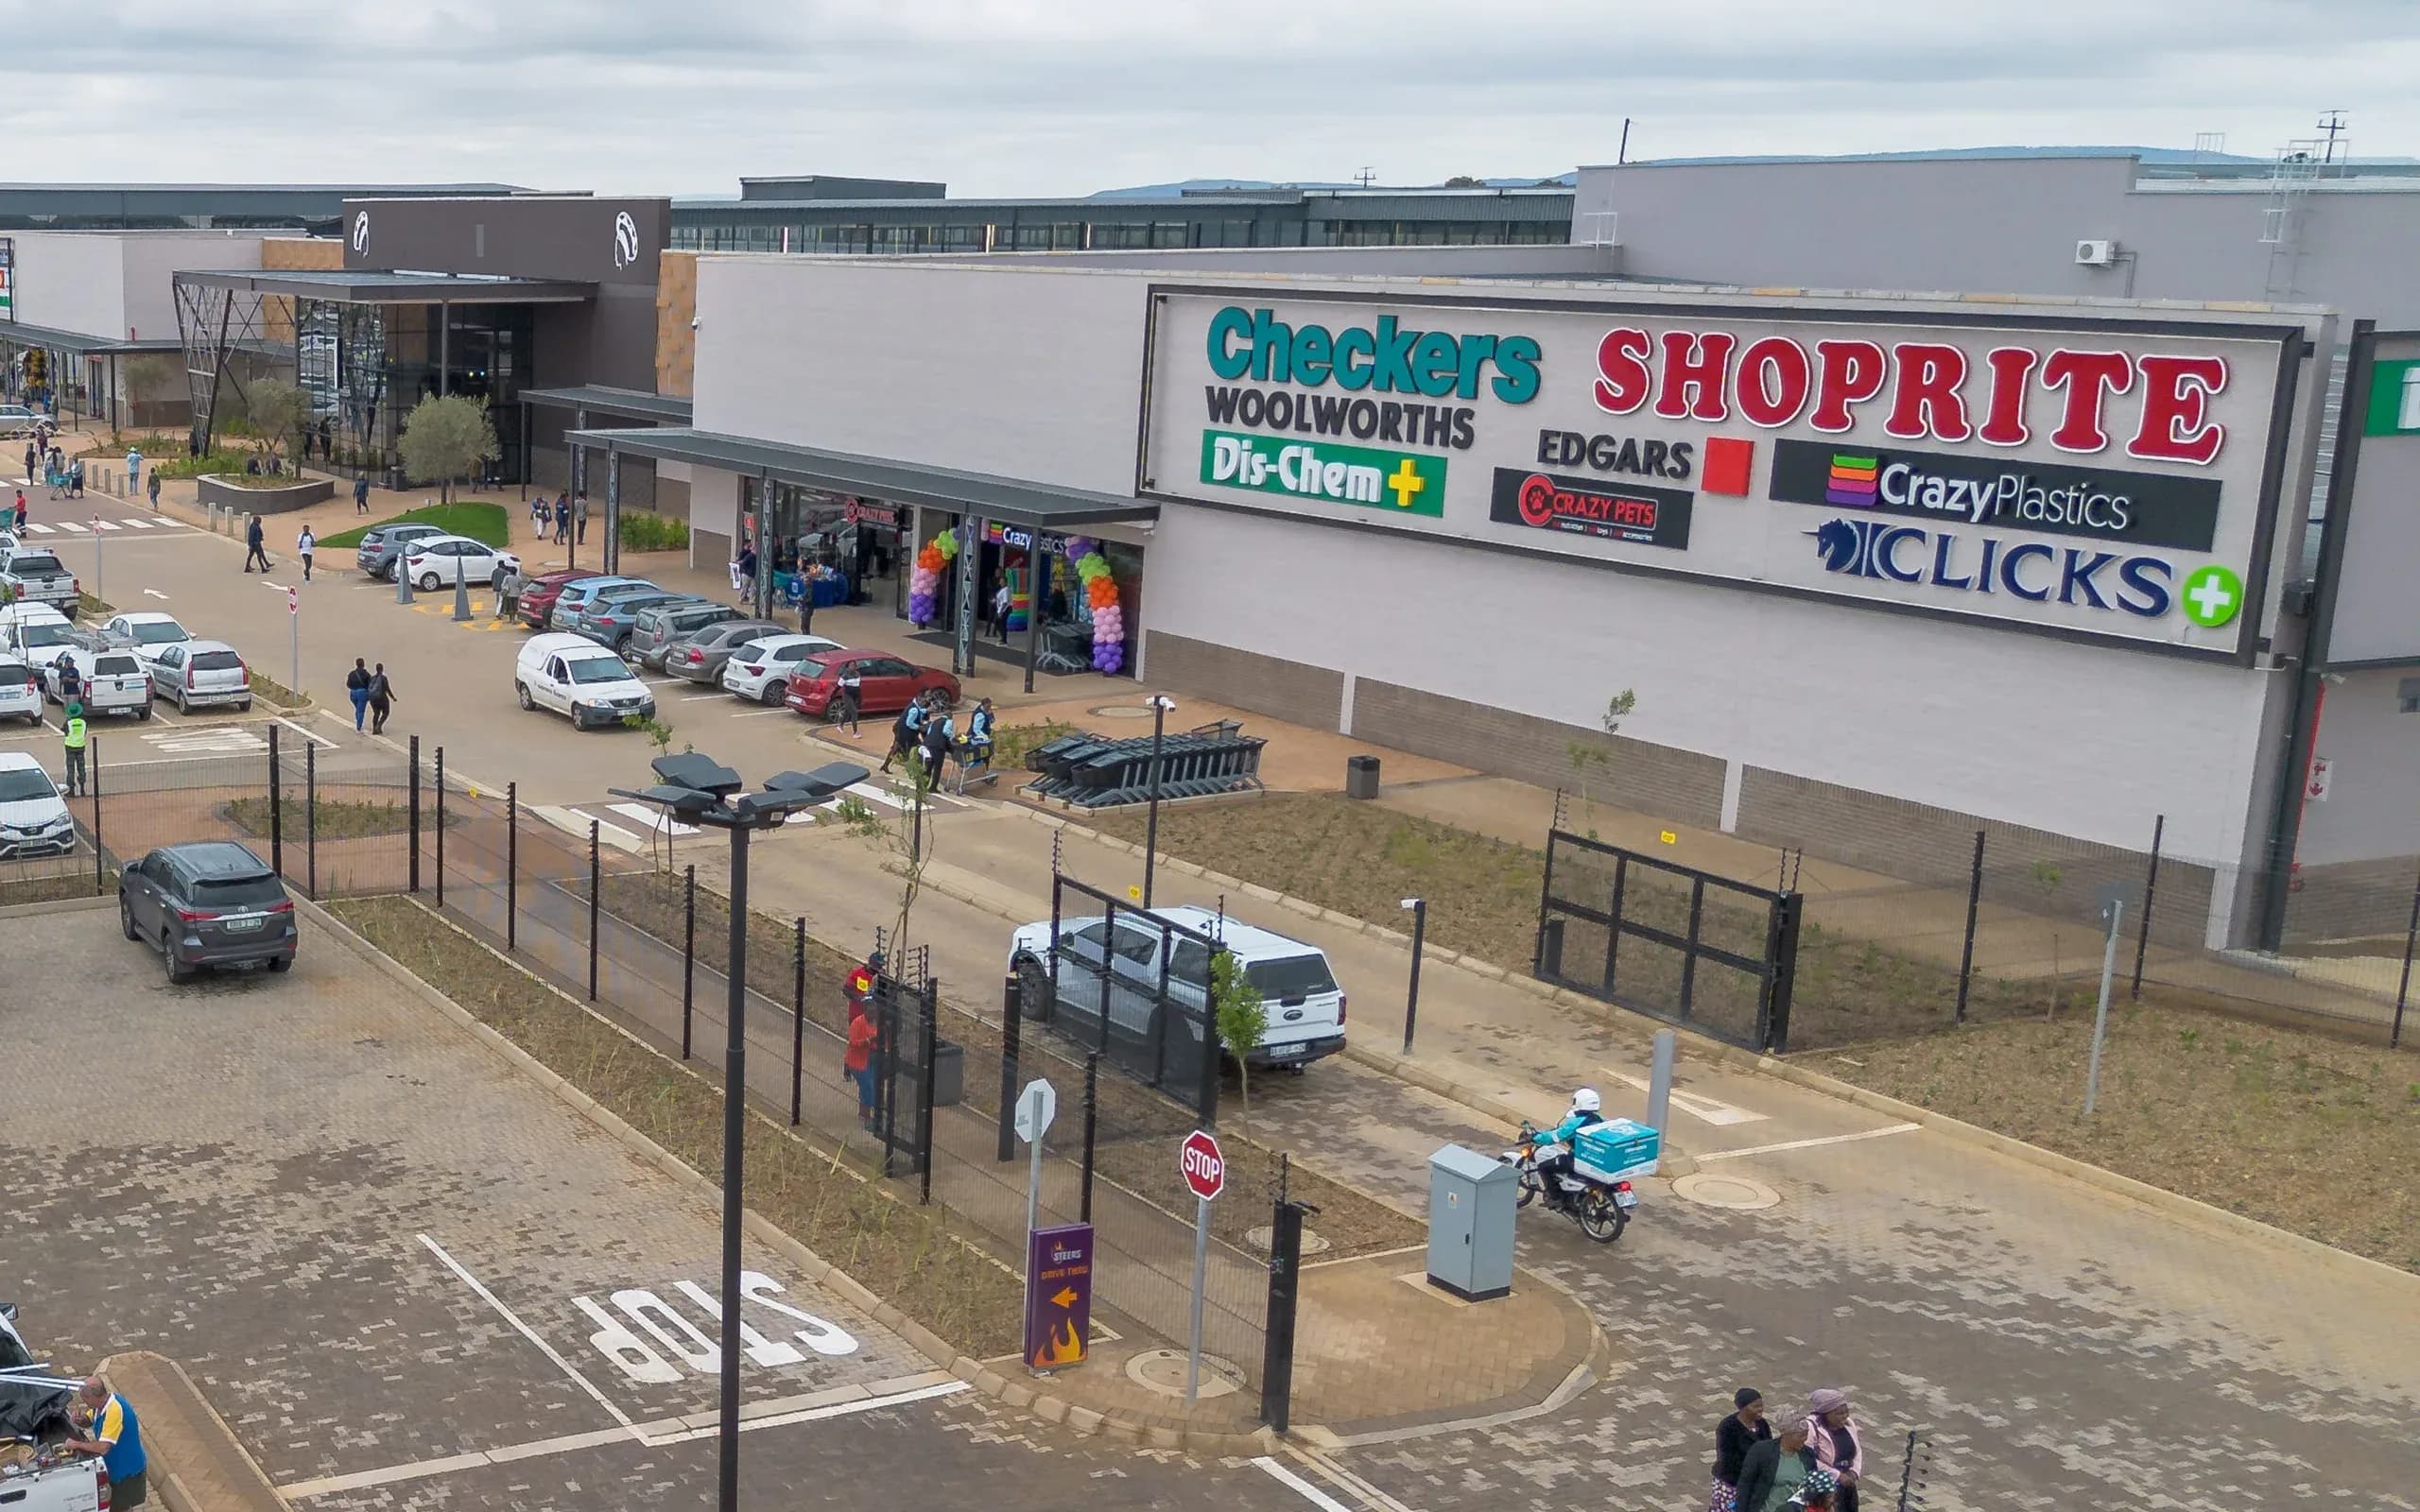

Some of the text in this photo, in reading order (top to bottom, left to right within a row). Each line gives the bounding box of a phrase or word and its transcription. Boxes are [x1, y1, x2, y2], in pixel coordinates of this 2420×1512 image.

[1207, 306, 1542, 404] Checkers
[1205, 386, 1475, 450] WOOLWORTHS
[1594, 327, 2229, 465] SHOPRITE
[1213, 437, 1382, 503] Dis-Chem
[1537, 429, 1694, 479] EDGARS
[1553, 492, 1654, 525] CRAZY PETS
[1877, 526, 2173, 617] CLICKS
[1185, 1146, 1220, 1183] STOP
[572, 1271, 858, 1383] STOP
